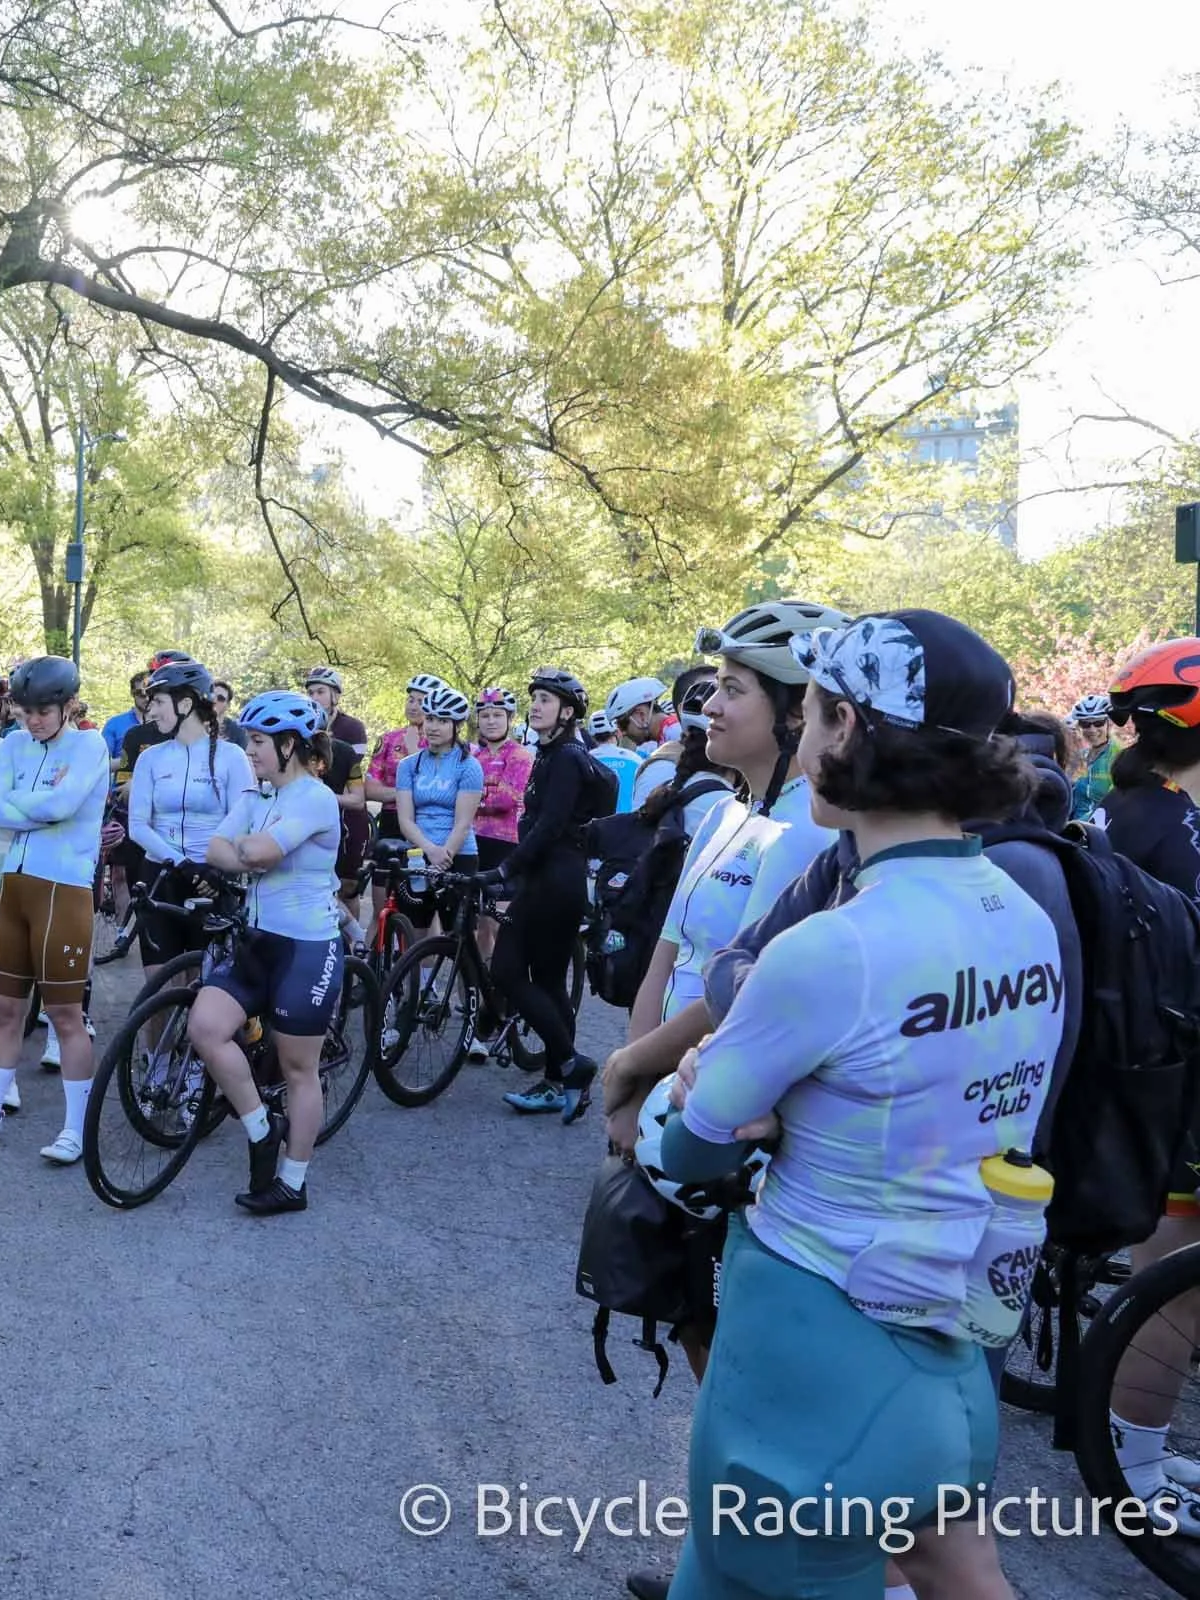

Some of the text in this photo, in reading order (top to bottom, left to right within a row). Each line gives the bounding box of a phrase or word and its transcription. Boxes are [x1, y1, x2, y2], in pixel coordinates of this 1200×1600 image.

[63, 945, 71, 953] P
[311, 942, 337, 1007] all.ways
[964, 1060, 1045, 1102] cycling
[978, 1090, 1031, 1124] club
